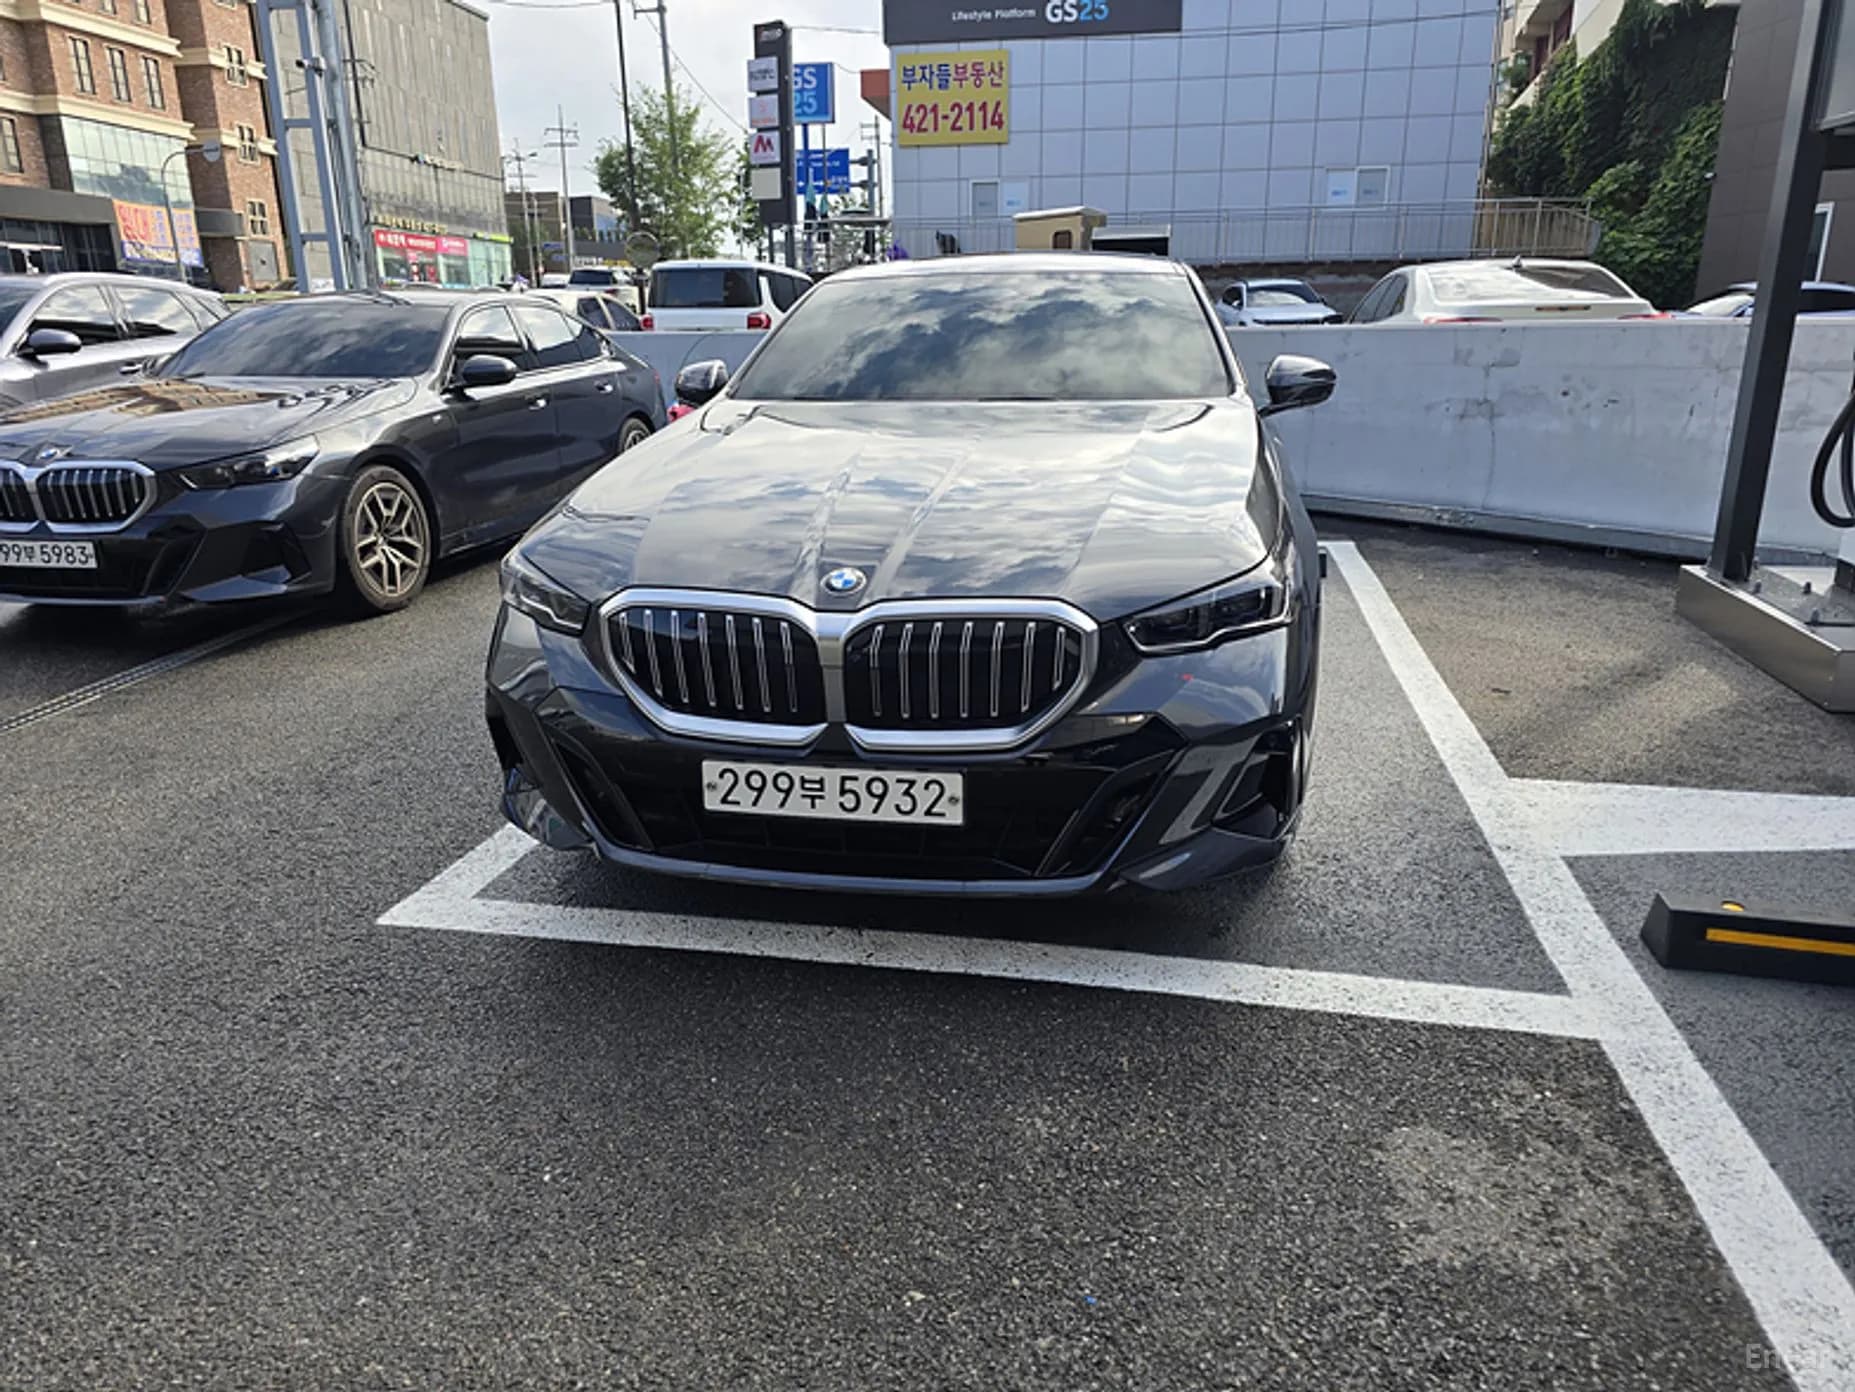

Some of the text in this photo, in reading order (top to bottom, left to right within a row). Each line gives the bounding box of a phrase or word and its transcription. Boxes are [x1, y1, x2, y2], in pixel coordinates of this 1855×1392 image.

[951, 0, 1109, 24] Lifestyle Platform GS25
[793, 66, 818, 89] GS
[793, 90, 818, 114] 25
[901, 100, 1004, 134] 421-2114
[40, 543, 89, 565] 5983
[839, 775, 947, 818] 5932
